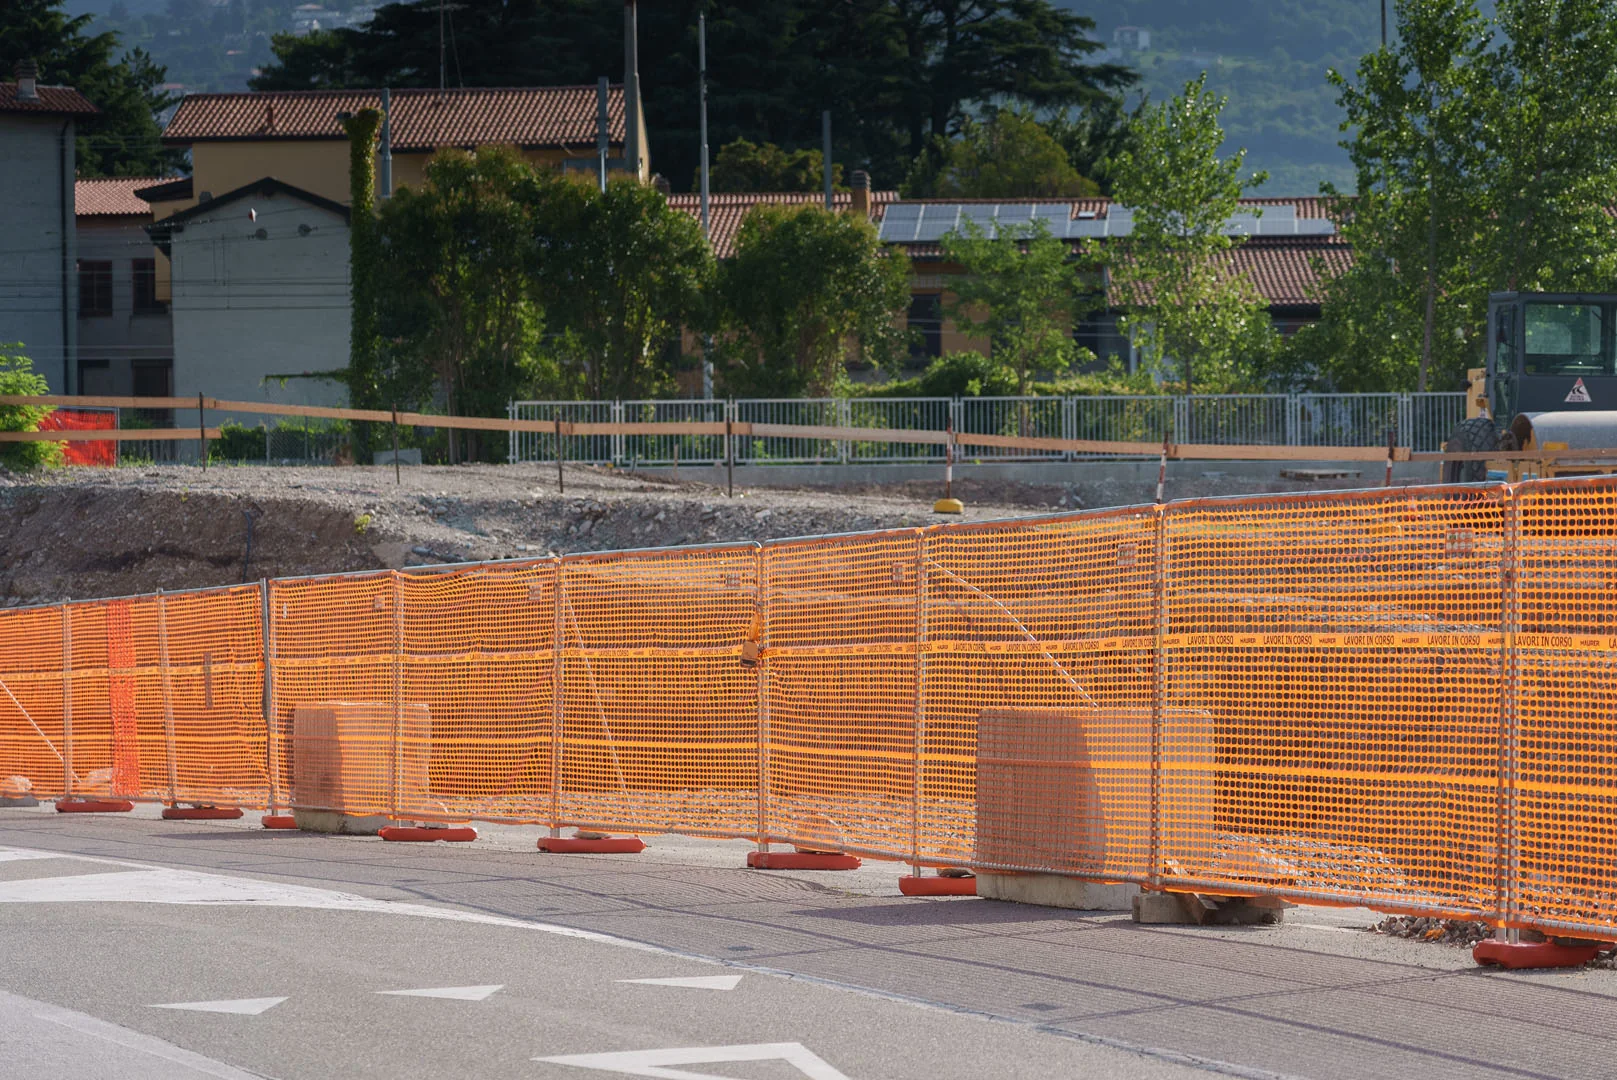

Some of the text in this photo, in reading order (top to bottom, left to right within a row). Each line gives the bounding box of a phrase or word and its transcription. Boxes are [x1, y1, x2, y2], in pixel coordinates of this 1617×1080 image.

[1187, 635, 1234, 645] LAVORI IN CORSO
[1264, 636, 1312, 644] LAVORI IN CORSO
[1344, 635, 1394, 645] LAVORI IN CORSO
[1427, 635, 1480, 645] LAVORI IN CORSO
[1513, 636, 1572, 647] LAVORI IN CORSO
